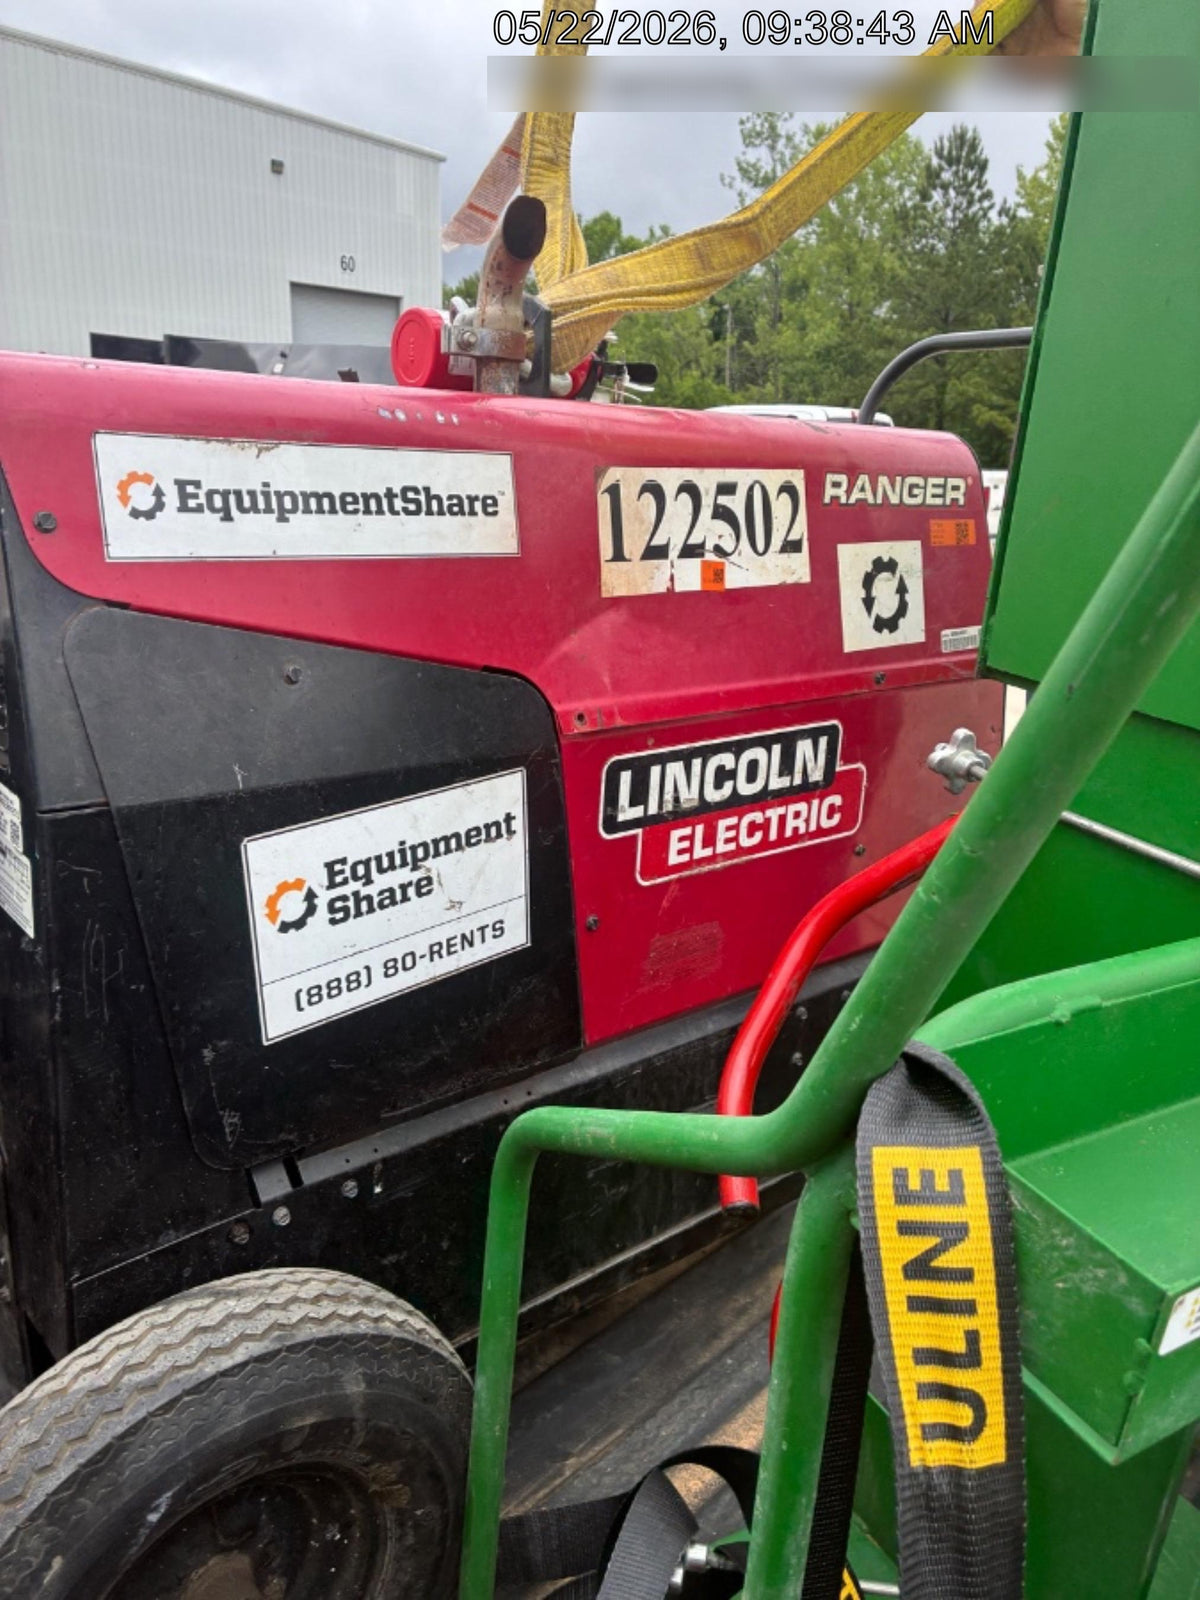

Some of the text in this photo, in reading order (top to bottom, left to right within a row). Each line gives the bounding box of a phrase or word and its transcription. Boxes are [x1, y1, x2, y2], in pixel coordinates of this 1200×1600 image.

[340, 254, 356, 272] 60
[174, 478, 500, 522] EquipmentShare
[601, 480, 804, 562] 122502
[823, 472, 967, 507] RANGER
[617, 735, 829, 822] LINCOLN
[323, 812, 517, 891] Equipment
[667, 794, 843, 866] ELECTRIC
[327, 875, 435, 927] Share
[294, 919, 506, 1012] (888) 80-RENTS
[893, 1168, 988, 1445] ULINE
